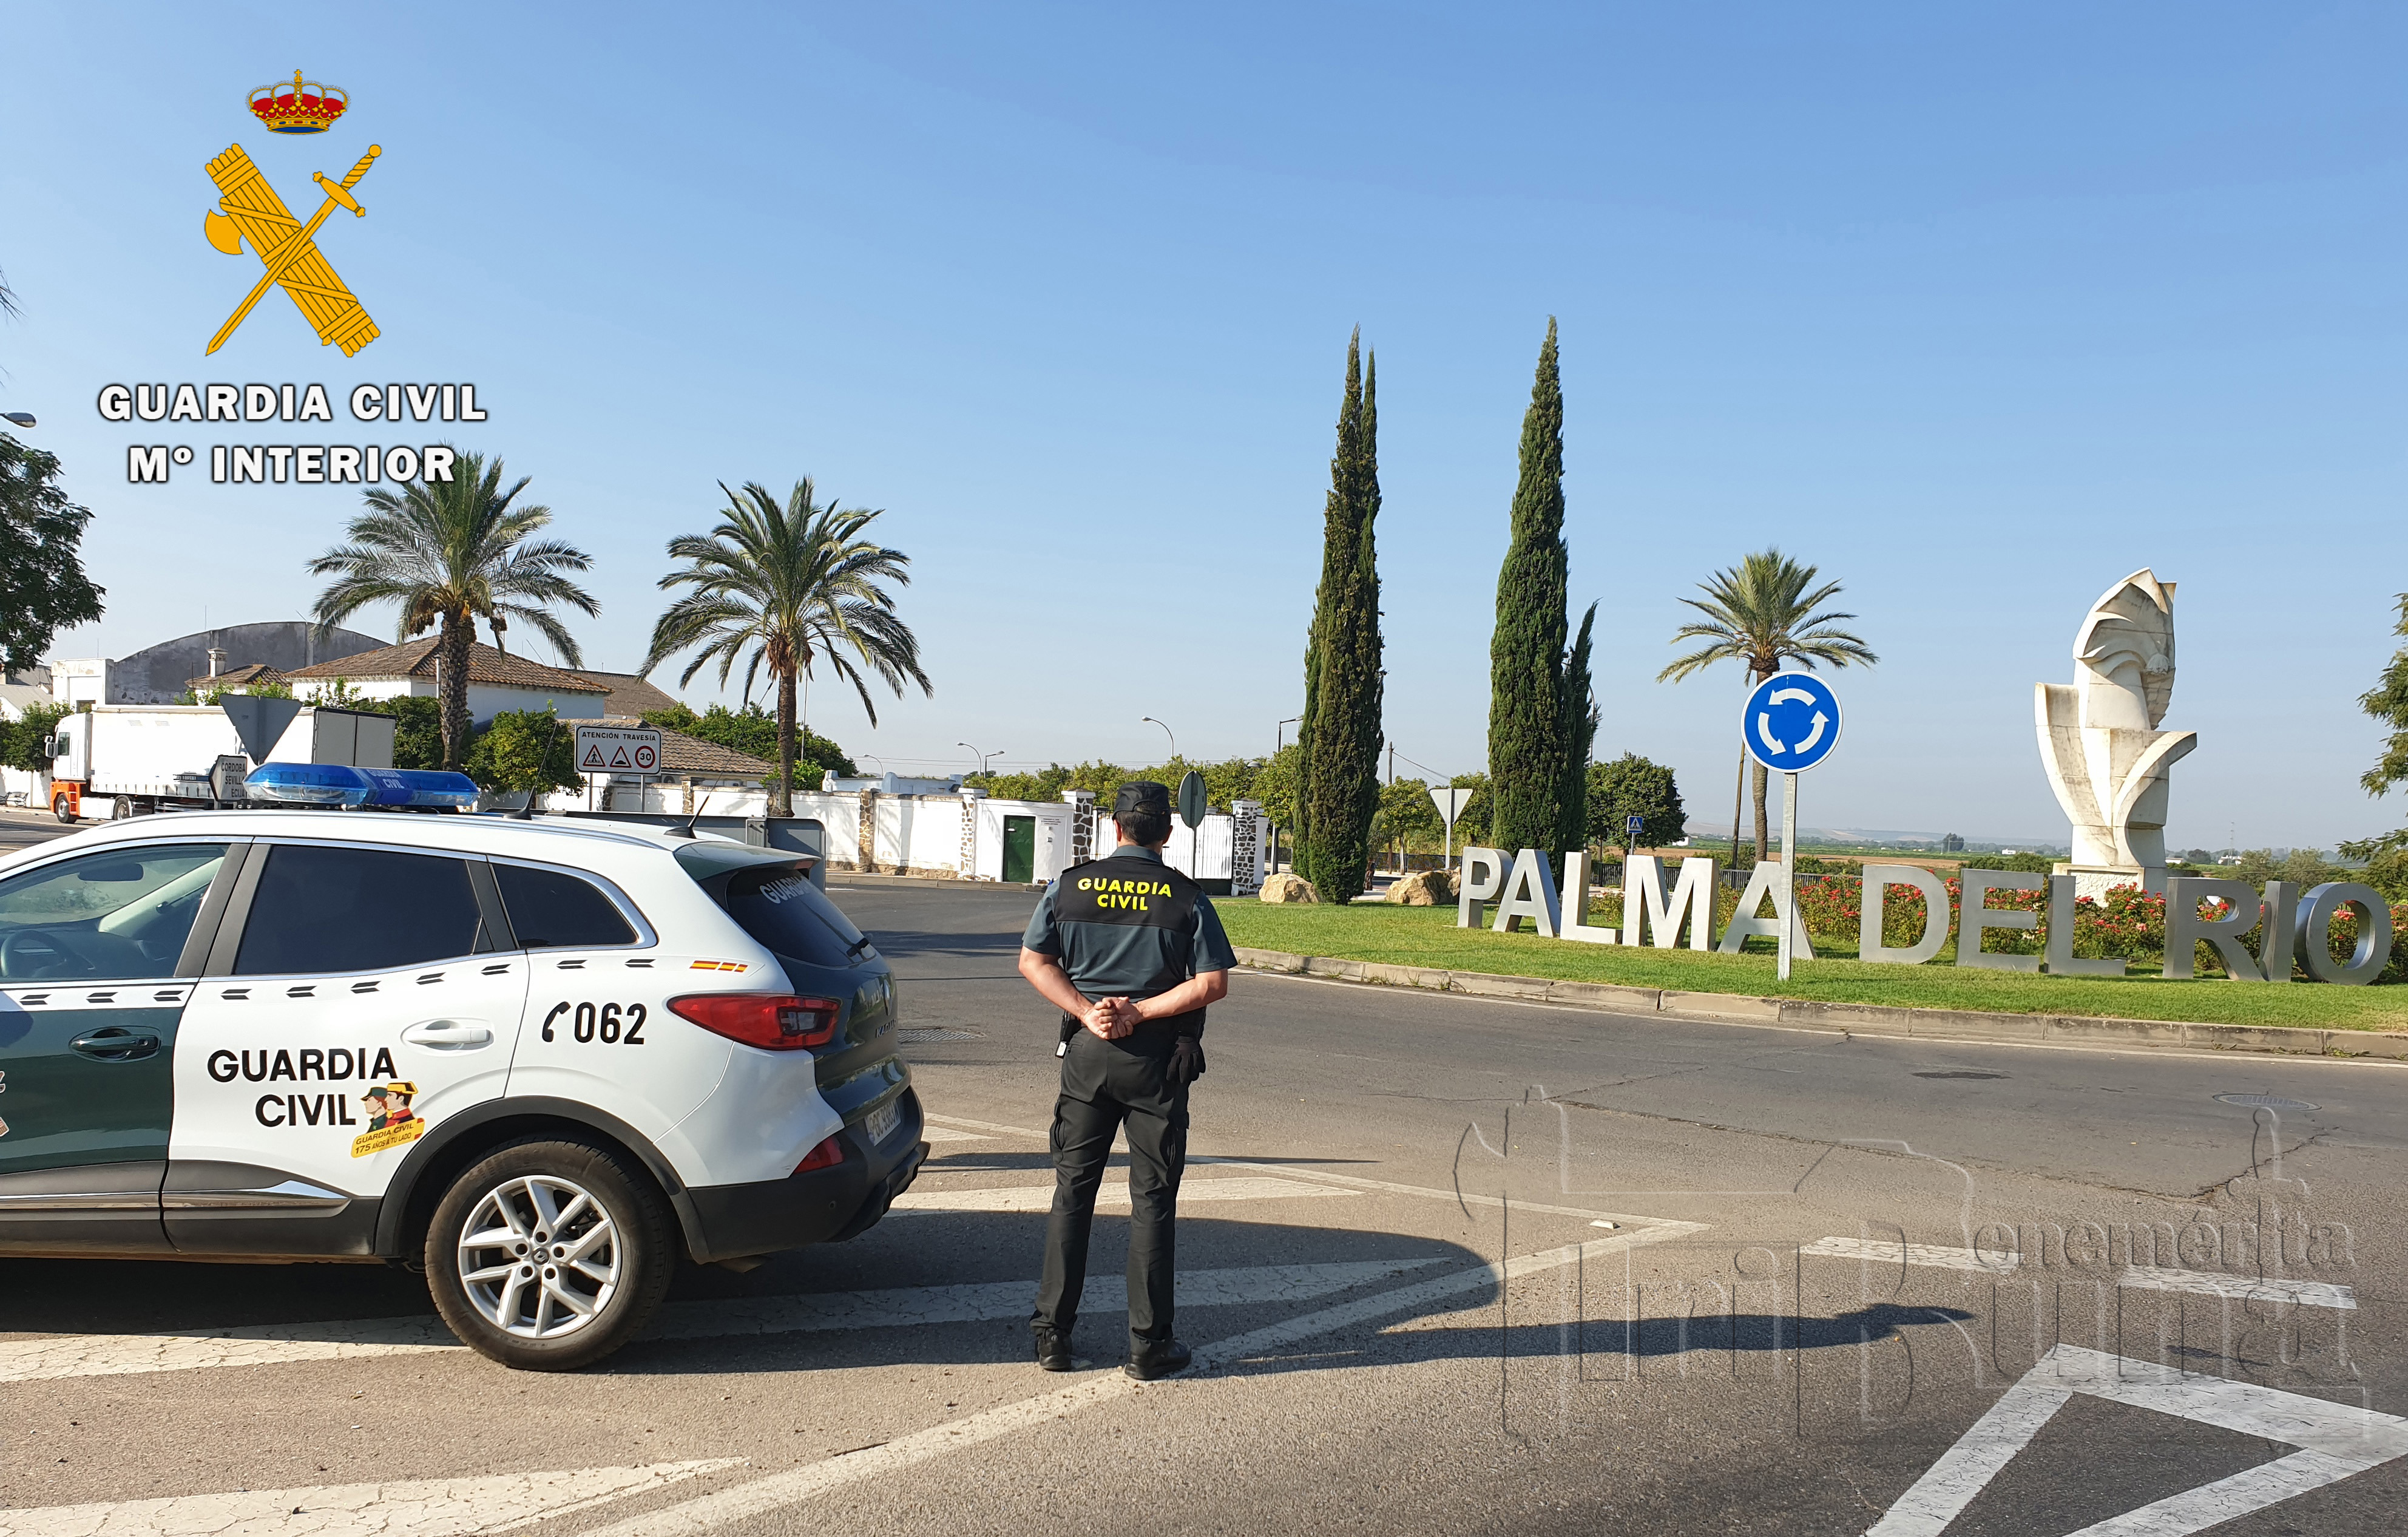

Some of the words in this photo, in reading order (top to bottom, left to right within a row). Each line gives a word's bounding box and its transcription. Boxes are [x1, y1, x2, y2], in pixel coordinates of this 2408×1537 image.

[581, 731, 619, 739] ATENCIÓN
[640, 752, 652, 761] 30
[382, 778, 405, 789] CIVIL
[1077, 878, 1172, 898] GUARDIA
[1097, 894, 1149, 911] CIVIL
[1457, 846, 1817, 960] PALMA
[1858, 864, 2126, 977] DEL
[2162, 877, 2393, 986] RIO
[573, 1002, 648, 1045] 062
[206, 1047, 399, 1083] GUARDIA
[254, 1093, 356, 1127] CIVIL
[355, 1144, 371, 1154] 175
[371, 1139, 385, 1149] AÑOS
[398, 1132, 412, 1142] LADO
[356, 1129, 391, 1145] GUARDIA
[393, 1123, 414, 1133] CIVIL
